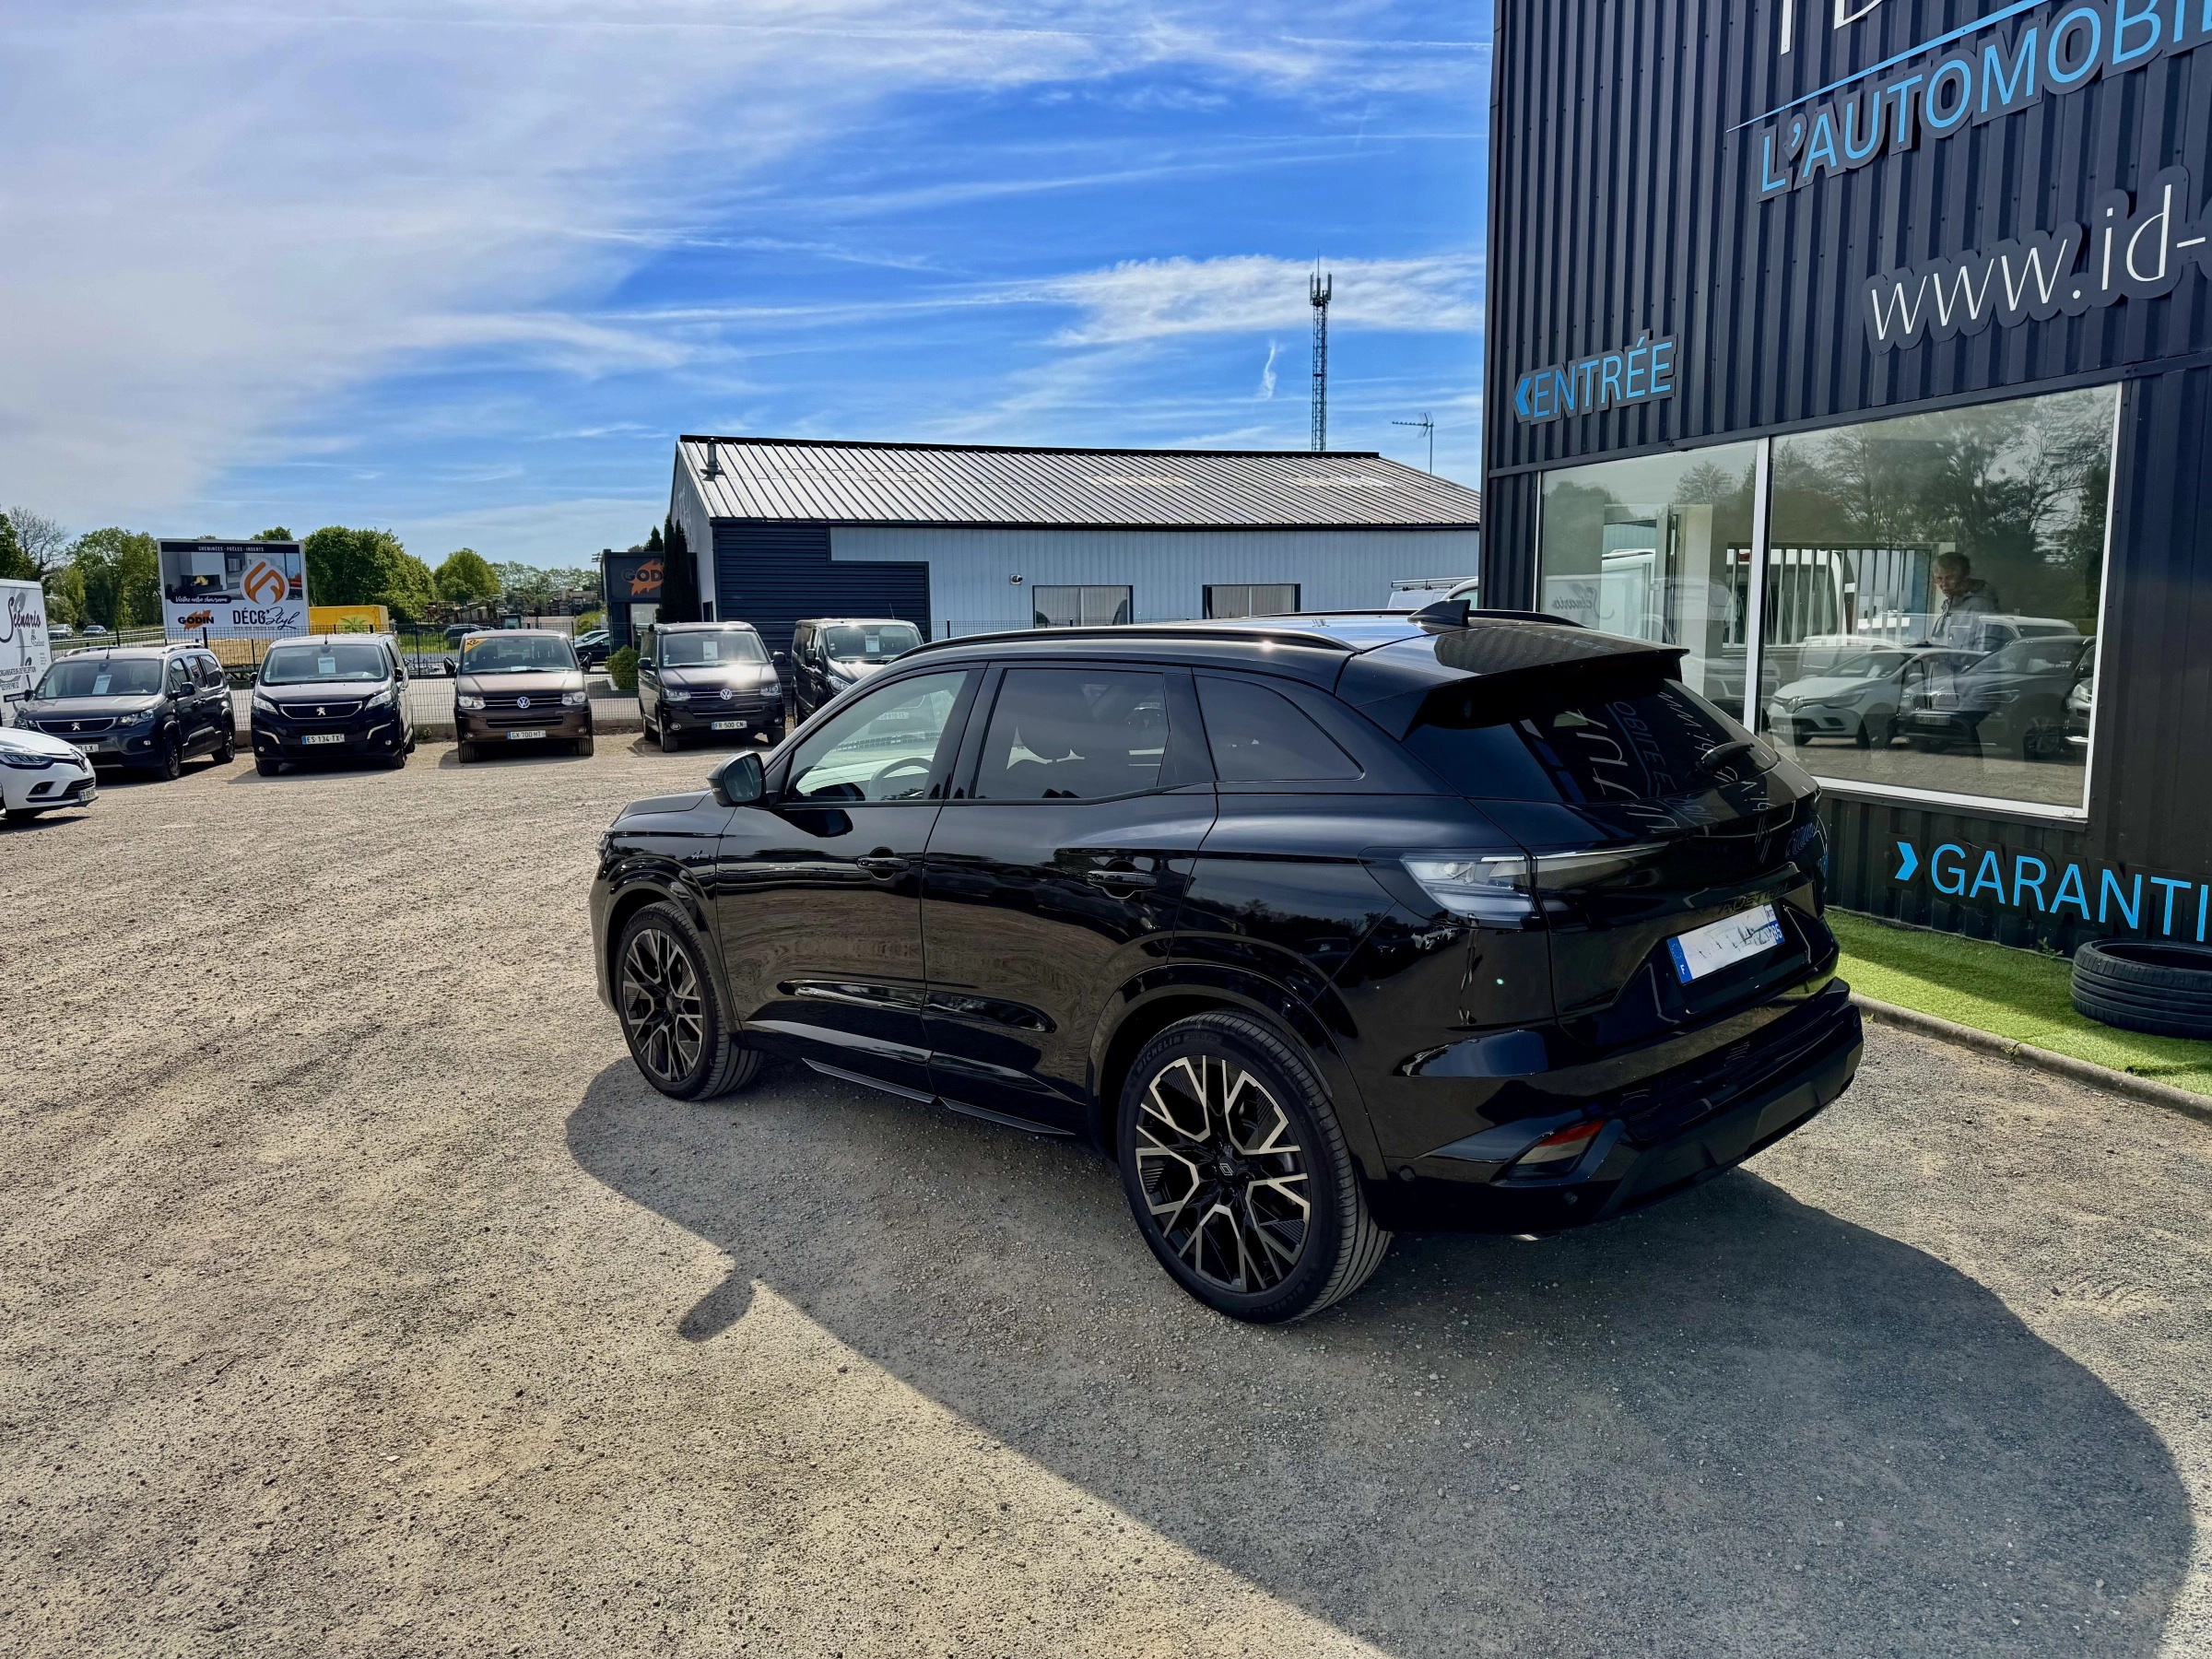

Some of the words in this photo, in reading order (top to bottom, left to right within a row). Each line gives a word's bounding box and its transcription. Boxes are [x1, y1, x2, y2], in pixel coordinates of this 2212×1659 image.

[1872, 183, 2206, 341] www.id-
[1534, 335, 1673, 418] ENTRÉE
[178, 616, 215, 625] GODIN
[1719, 882, 1790, 915] AUSTRAL
[1931, 843, 2209, 942] GARANTI
